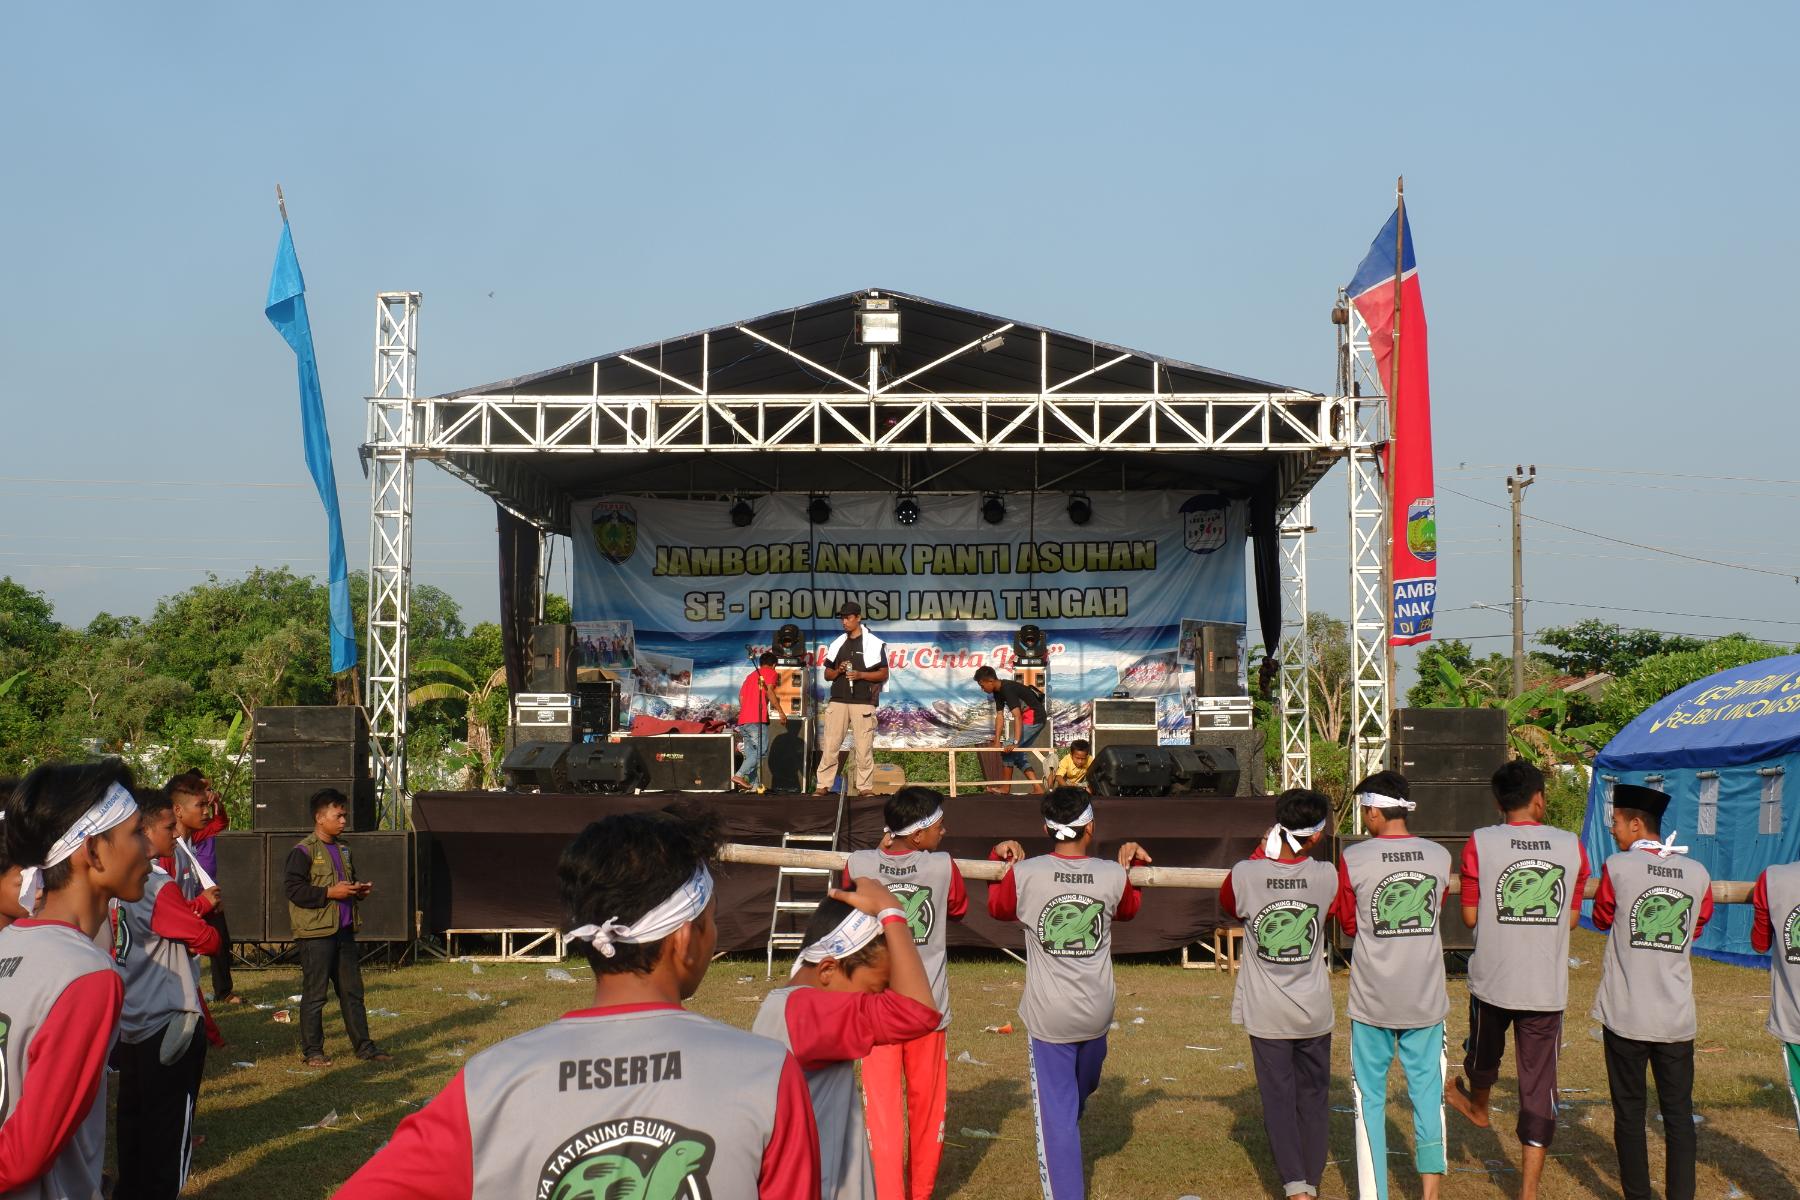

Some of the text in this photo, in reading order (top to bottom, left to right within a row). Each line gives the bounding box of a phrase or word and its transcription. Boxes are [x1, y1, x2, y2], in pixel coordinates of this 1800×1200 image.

[653, 540, 1157, 577] JAMBORE ANAK PANTI ASUHAN
[1394, 582, 1435, 600] AMB
[749, 587, 901, 621] PROVINSI
[905, 589, 998, 621] JAWA
[1000, 586, 1128, 620] TENGAH
[914, 647, 985, 669] Cinta
[1510, 838, 1552, 851] PESERTA
[1382, 850, 1425, 863] PESERTA
[879, 863, 918, 876] PESERTA
[1054, 871, 1095, 885] PESERTA
[1647, 863, 1684, 880] PESERTA
[1266, 878, 1308, 890] PESERTA
[559, 1050, 682, 1092] PESERTA
[548, 1119, 676, 1176] TATANING BUMI
